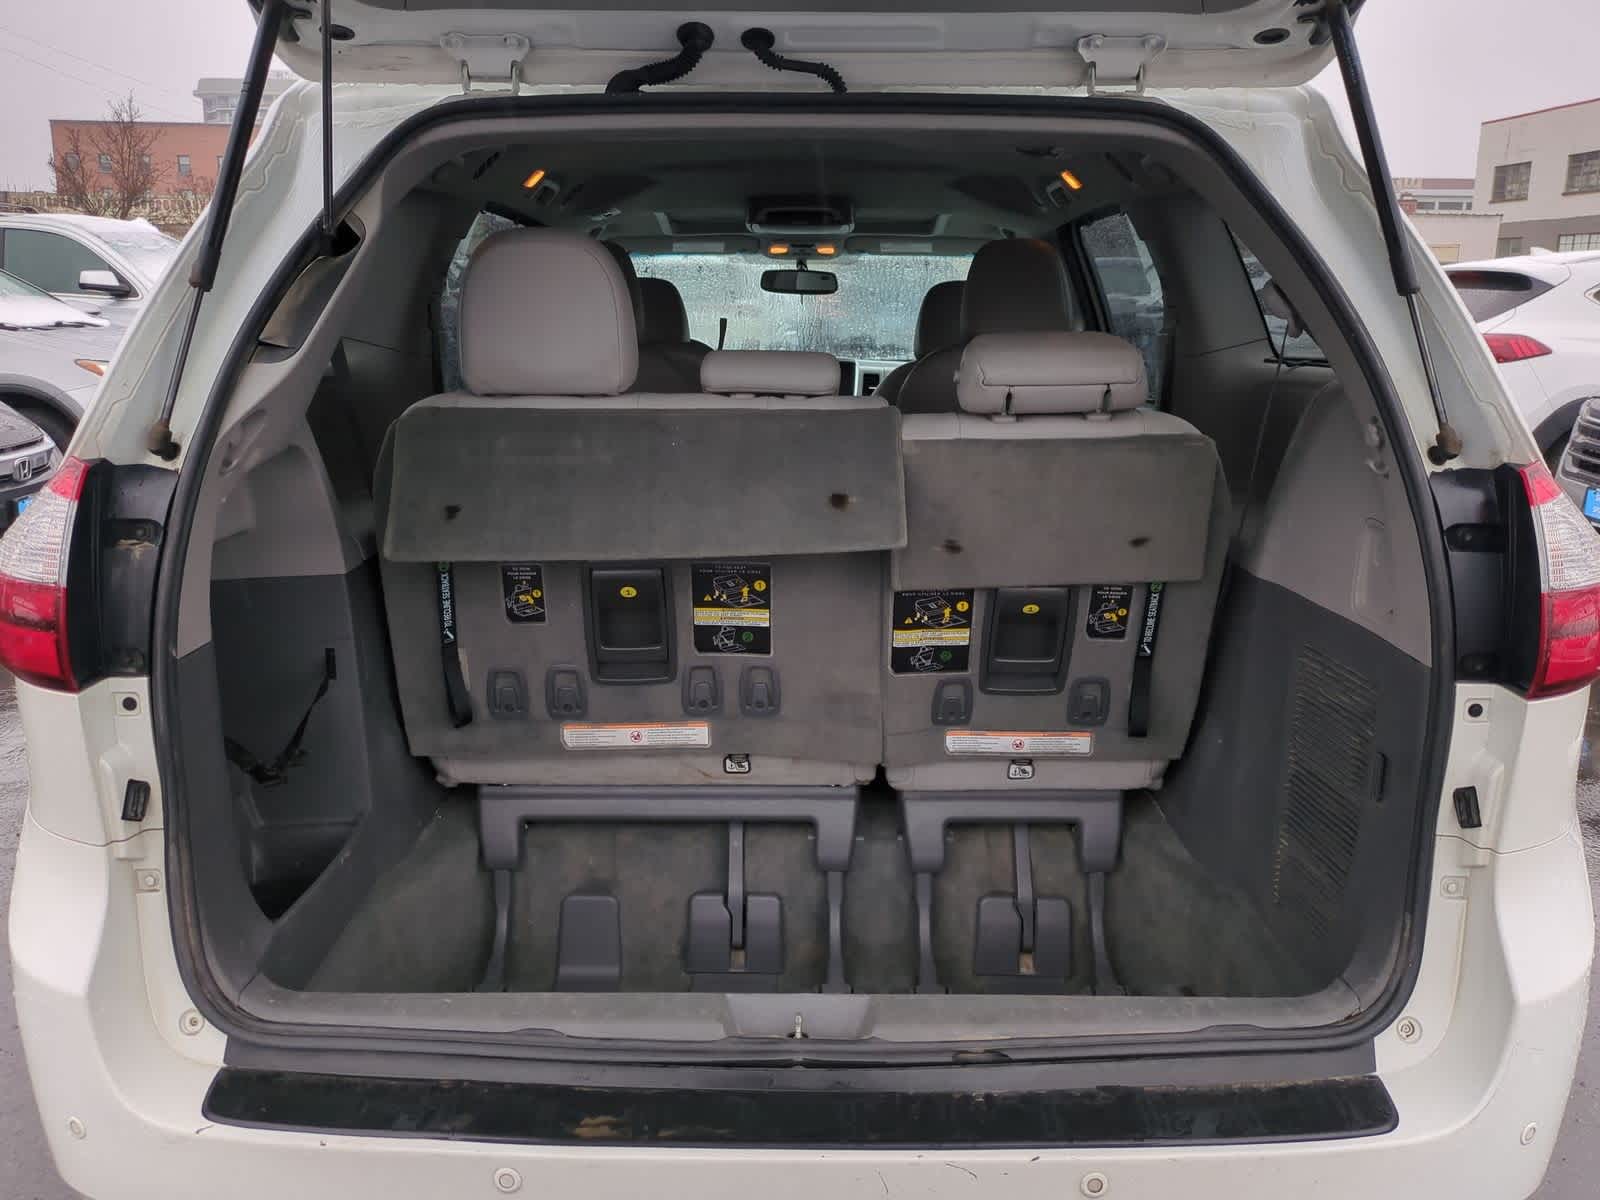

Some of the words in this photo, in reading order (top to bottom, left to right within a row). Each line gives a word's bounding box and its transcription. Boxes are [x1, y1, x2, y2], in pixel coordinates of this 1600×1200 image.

[440, 573, 450, 599] SEATBACK
[442, 599, 451, 620] RECLINE
[1147, 592, 1159, 617] SEATBACK
[1144, 617, 1155, 636] RECLINE
